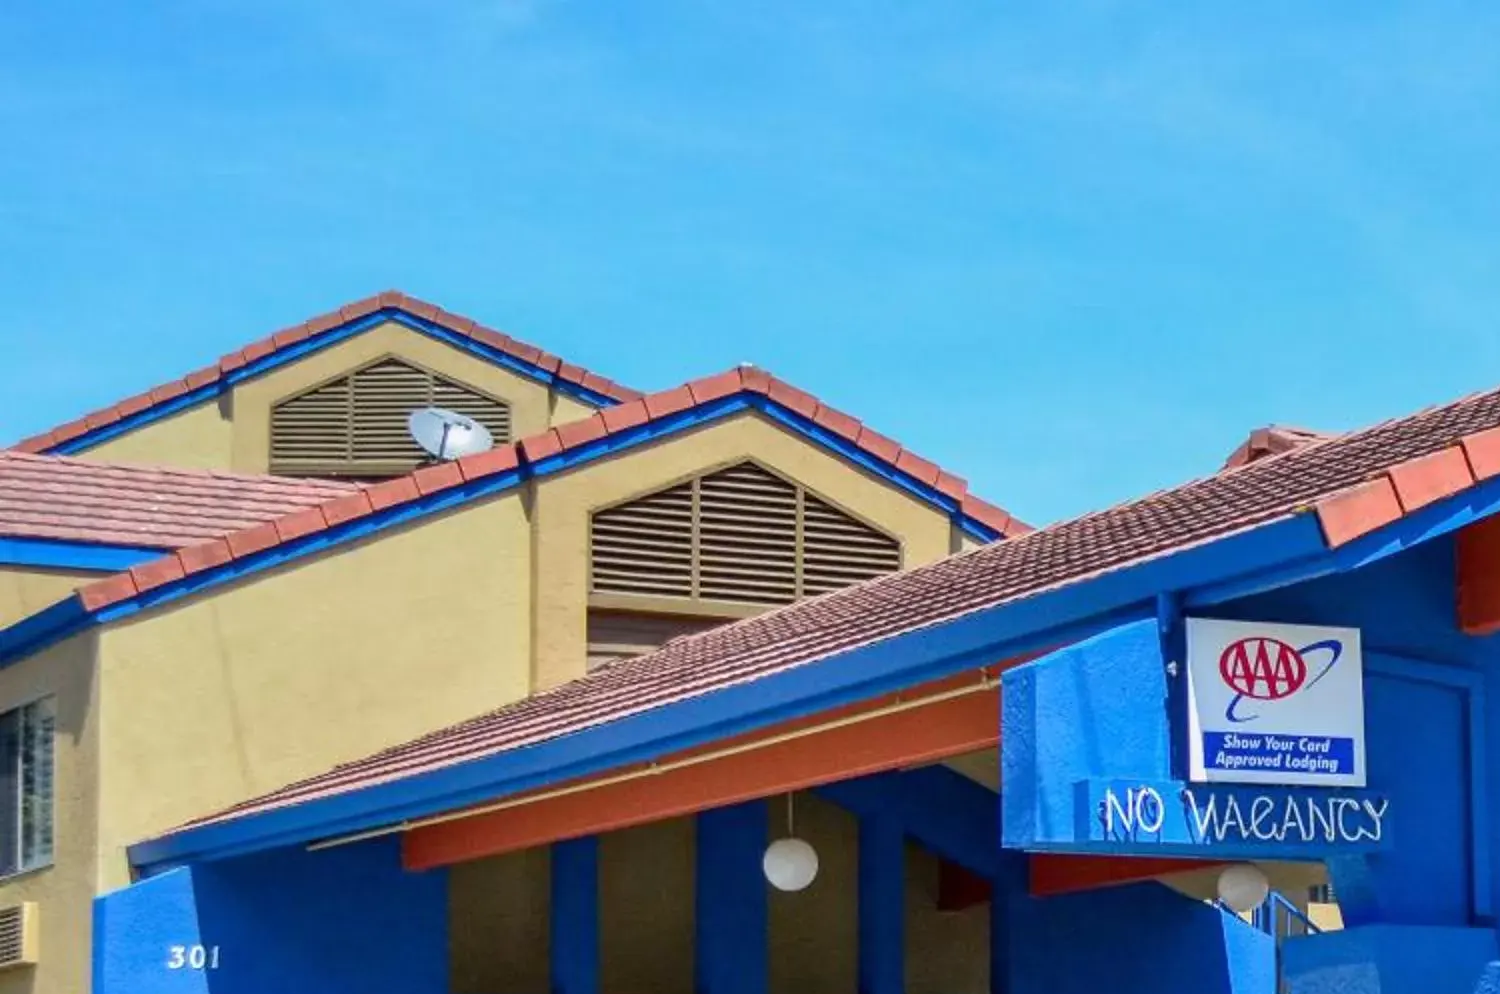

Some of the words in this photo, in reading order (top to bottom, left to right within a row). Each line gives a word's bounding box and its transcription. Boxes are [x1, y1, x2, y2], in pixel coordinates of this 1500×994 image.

[1220, 637, 1307, 700] AAA
[1223, 734, 1261, 749] Show
[1265, 735, 1295, 751] Your
[1299, 737, 1331, 752] Card
[1215, 750, 1282, 769] Approved
[1285, 753, 1339, 772] Lodging
[1102, 786, 1165, 834] NO
[1184, 788, 1389, 842] VACANCY
[167, 944, 220, 969] 301
